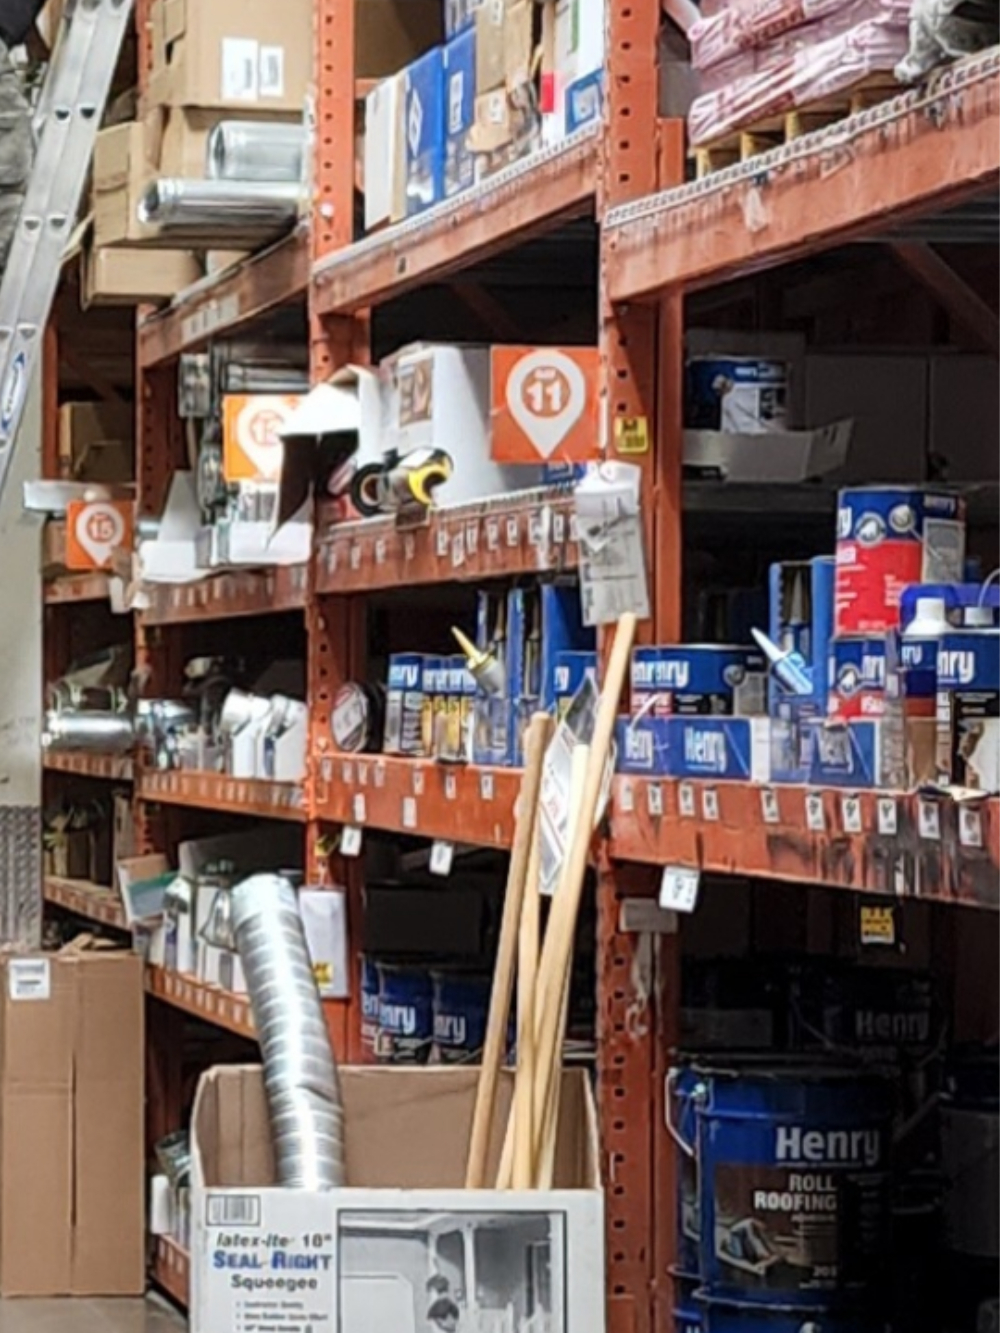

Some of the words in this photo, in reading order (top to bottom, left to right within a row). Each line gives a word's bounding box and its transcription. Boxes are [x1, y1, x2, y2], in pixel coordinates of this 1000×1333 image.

[527, 381, 564, 412] 11
[937, 650, 975, 684] nry
[856, 1010, 930, 1041] Henry
[775, 1126, 880, 1167] Henry
[788, 1174, 837, 1192] ROLL
[754, 1191, 837, 1211] ROOFING
[271, 1251, 333, 1269] RIGHT
[231, 1275, 318, 1291] Squeegee
